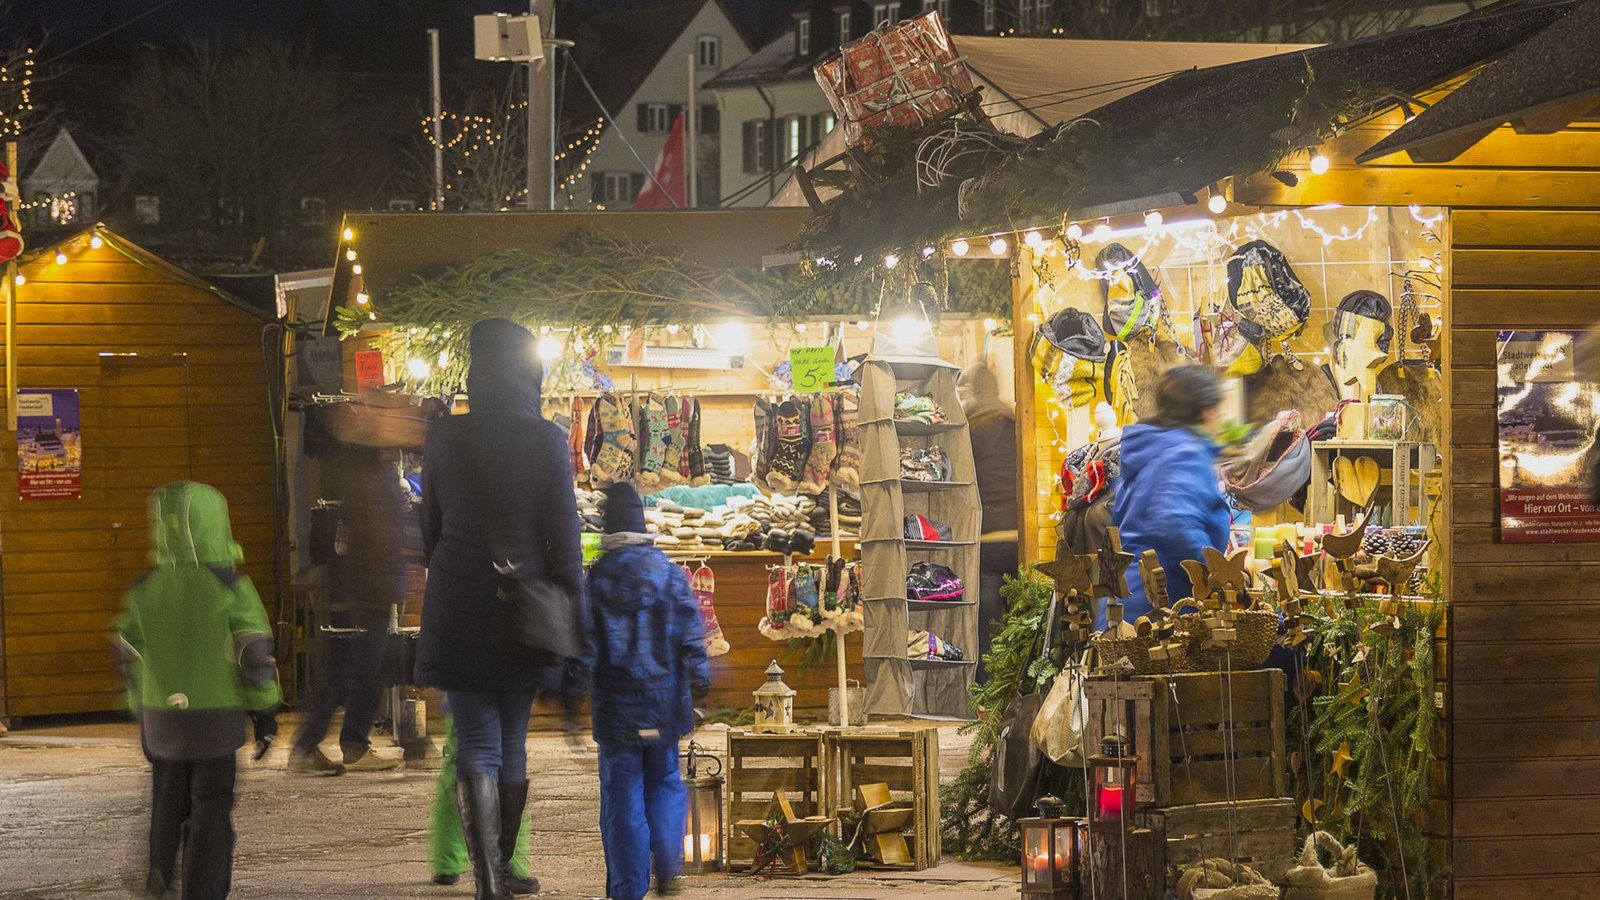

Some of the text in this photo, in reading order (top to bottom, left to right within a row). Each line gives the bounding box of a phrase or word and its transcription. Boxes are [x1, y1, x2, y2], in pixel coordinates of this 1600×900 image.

[1502, 350, 1547, 360] Stadtwer
[1524, 503, 1541, 514] Hier
[1543, 504, 1557, 513] vor
[1558, 502, 1572, 513] Ort
[1580, 503, 1595, 513] von
